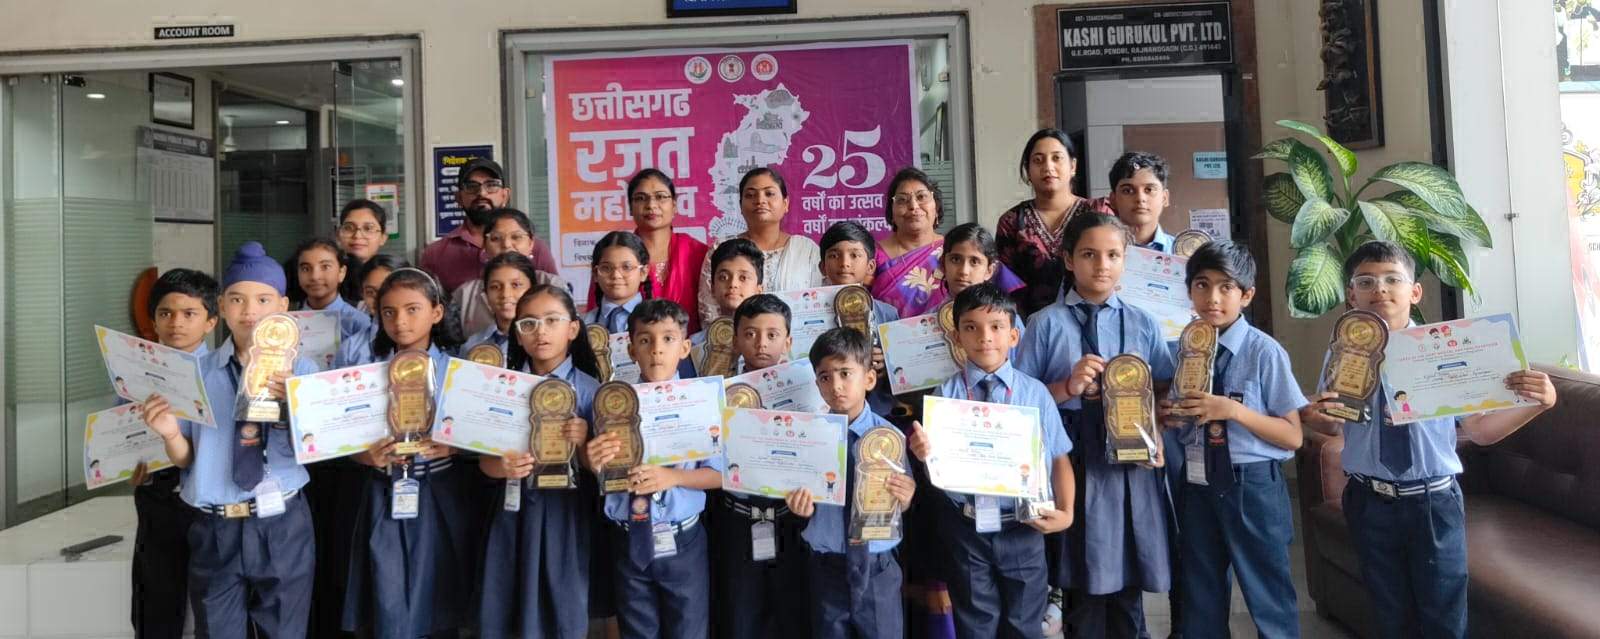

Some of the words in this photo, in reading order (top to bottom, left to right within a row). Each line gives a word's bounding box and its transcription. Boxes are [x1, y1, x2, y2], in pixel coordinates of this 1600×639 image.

[159, 27, 201, 37] ACCOUNT
[201, 26, 230, 36] ROOM
[1064, 28, 1103, 47] KASHI
[1107, 24, 1167, 45] GURUKUL
[1170, 23, 1197, 42] PVT.
[1200, 22, 1226, 41] LTD.
[568, 82, 693, 121] छत्तीसगढ
[569, 127, 695, 183] रजत
[802, 124, 886, 189] 25
[570, 180, 698, 222] महोव
[801, 190, 826, 211] वर्षों
[827, 195, 846, 210] का
[847, 193, 884, 210] उत्सव
